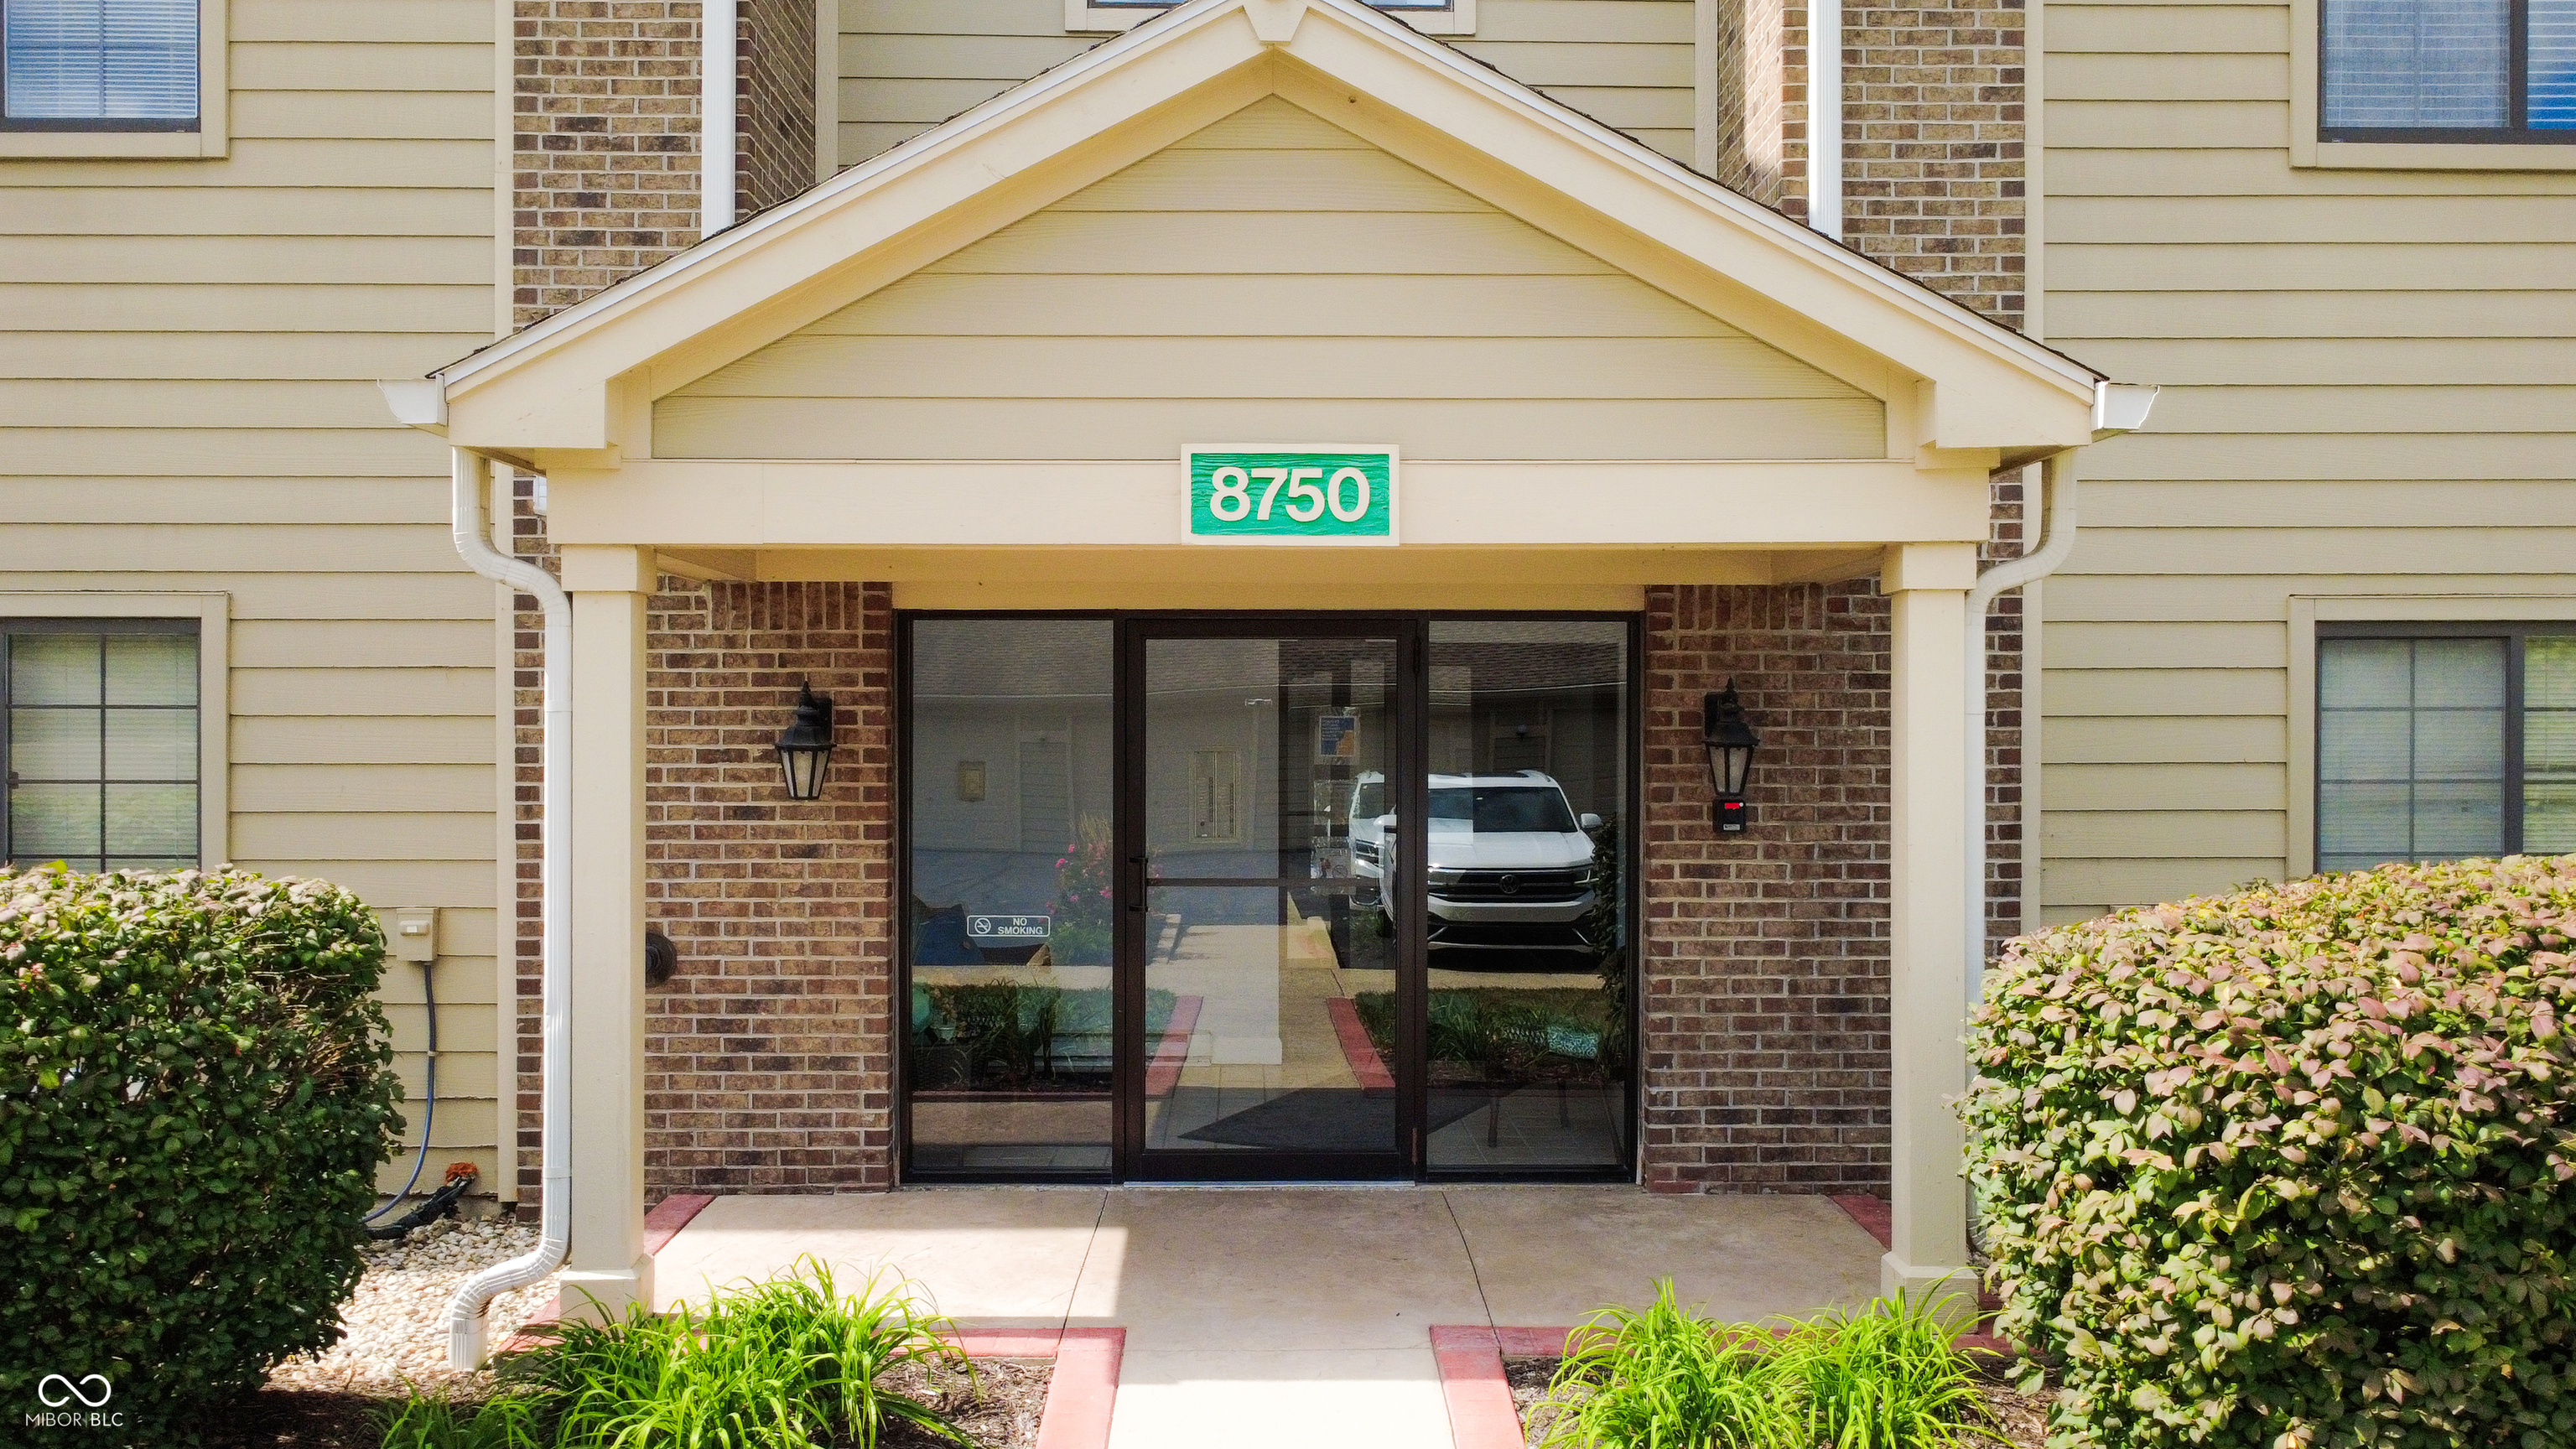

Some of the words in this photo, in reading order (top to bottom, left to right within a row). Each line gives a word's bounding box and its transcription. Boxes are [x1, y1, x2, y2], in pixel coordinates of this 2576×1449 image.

[1210, 466, 1370, 522] 8750
[1013, 917, 1027, 926] NO
[998, 927, 1043, 935] SMOKING
